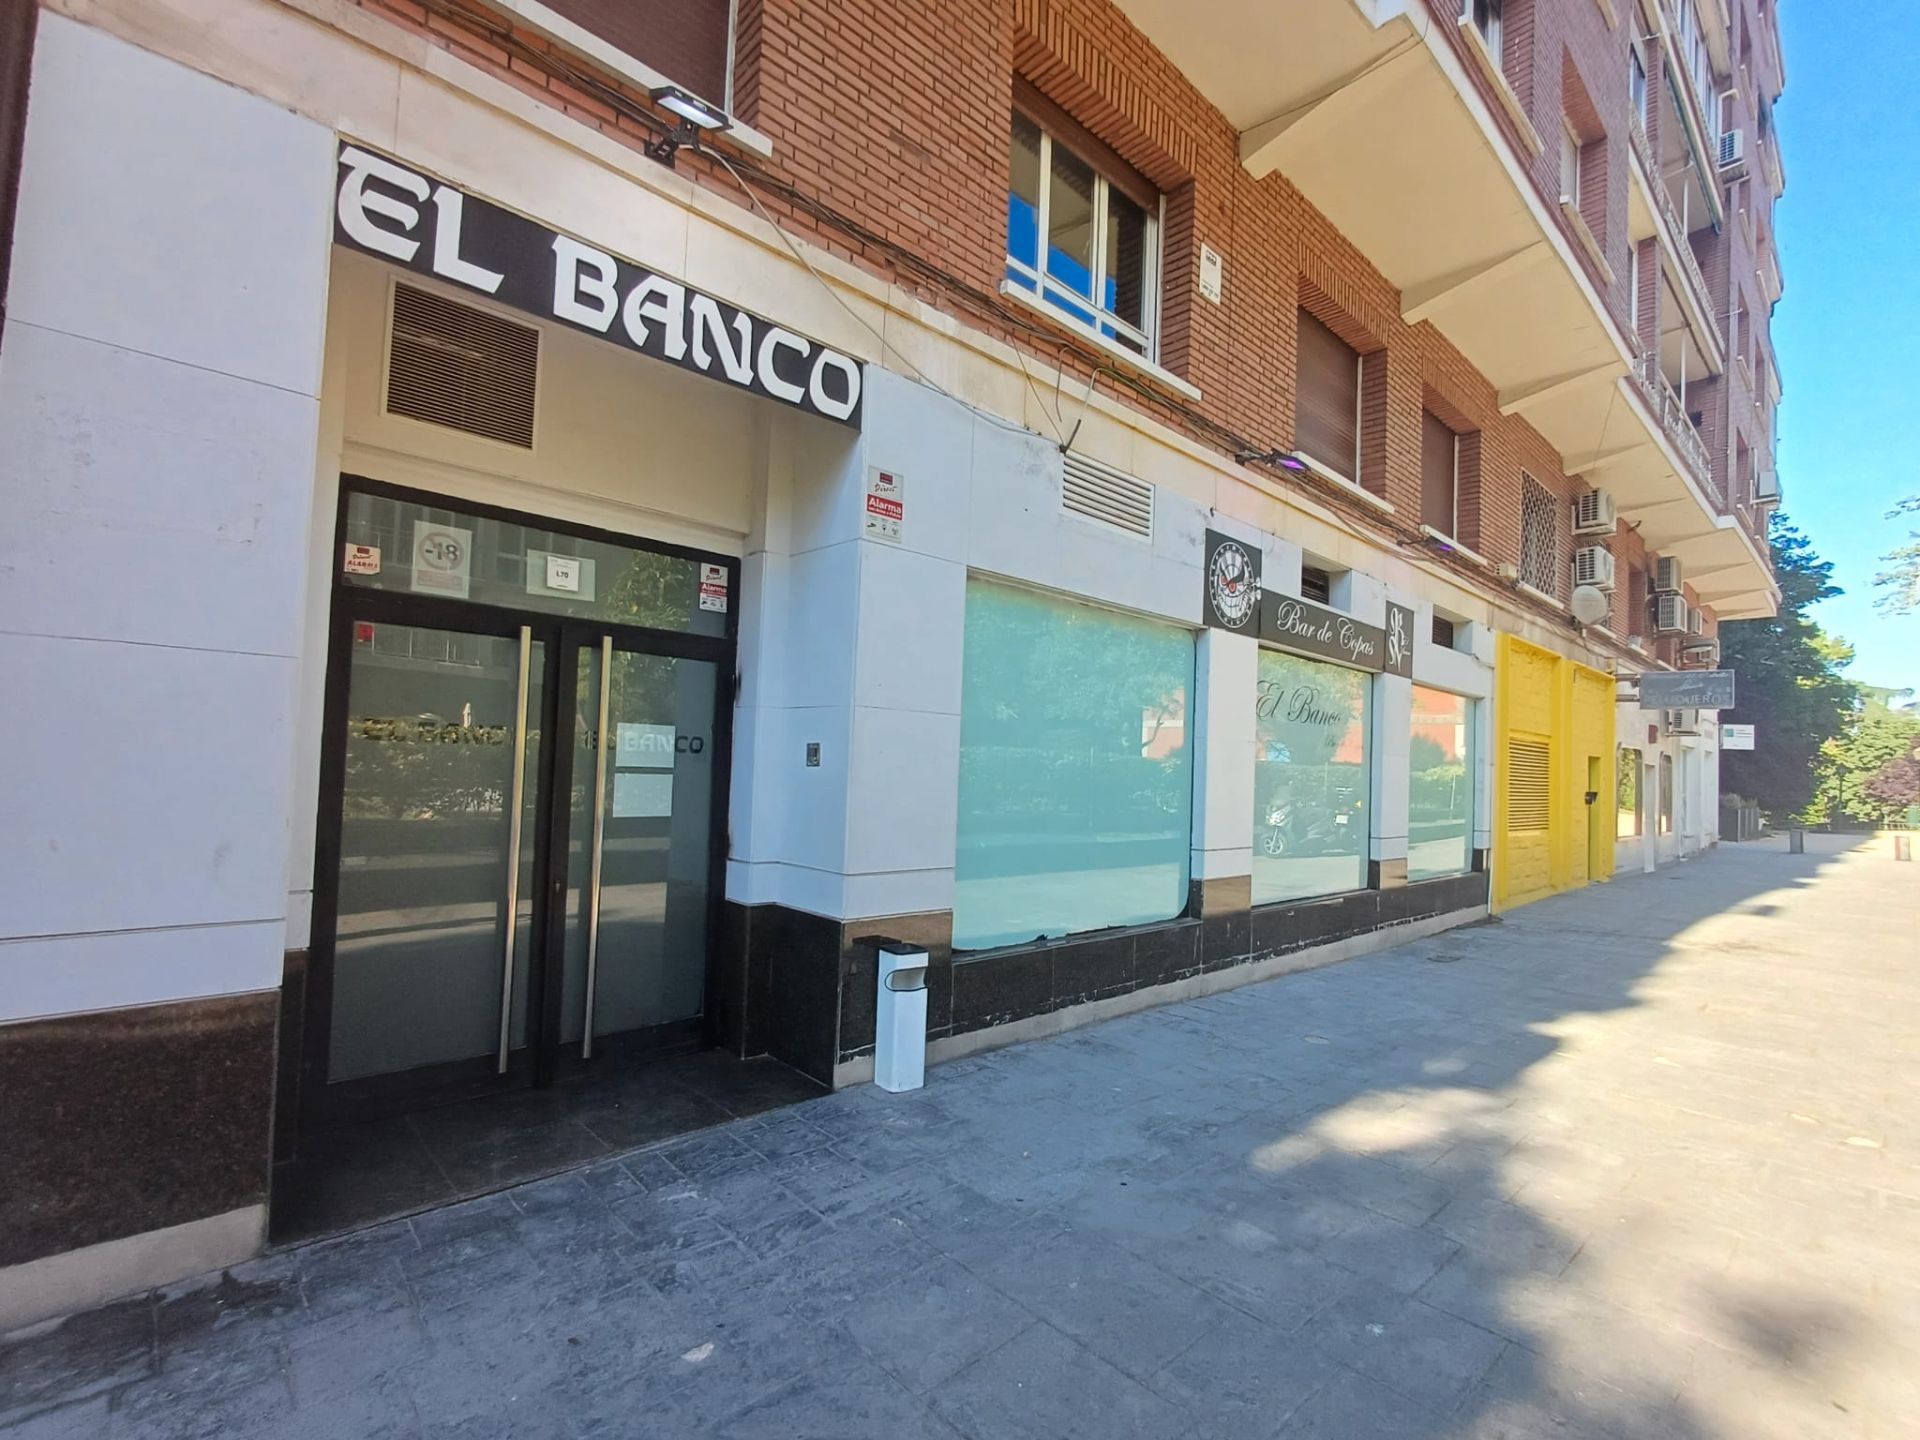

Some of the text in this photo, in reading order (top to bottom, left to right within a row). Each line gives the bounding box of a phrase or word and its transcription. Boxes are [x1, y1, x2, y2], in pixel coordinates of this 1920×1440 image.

[337, 146, 861, 421] EL BANCO
[868, 498, 902, 514] Alarma
[425, 543, 458, 562] -18
[1277, 600, 1316, 638] Bar
[1317, 621, 1333, 643] de
[1336, 617, 1375, 661] Copas
[1256, 680, 1285, 719] El
[622, 731, 704, 754] BANCO
